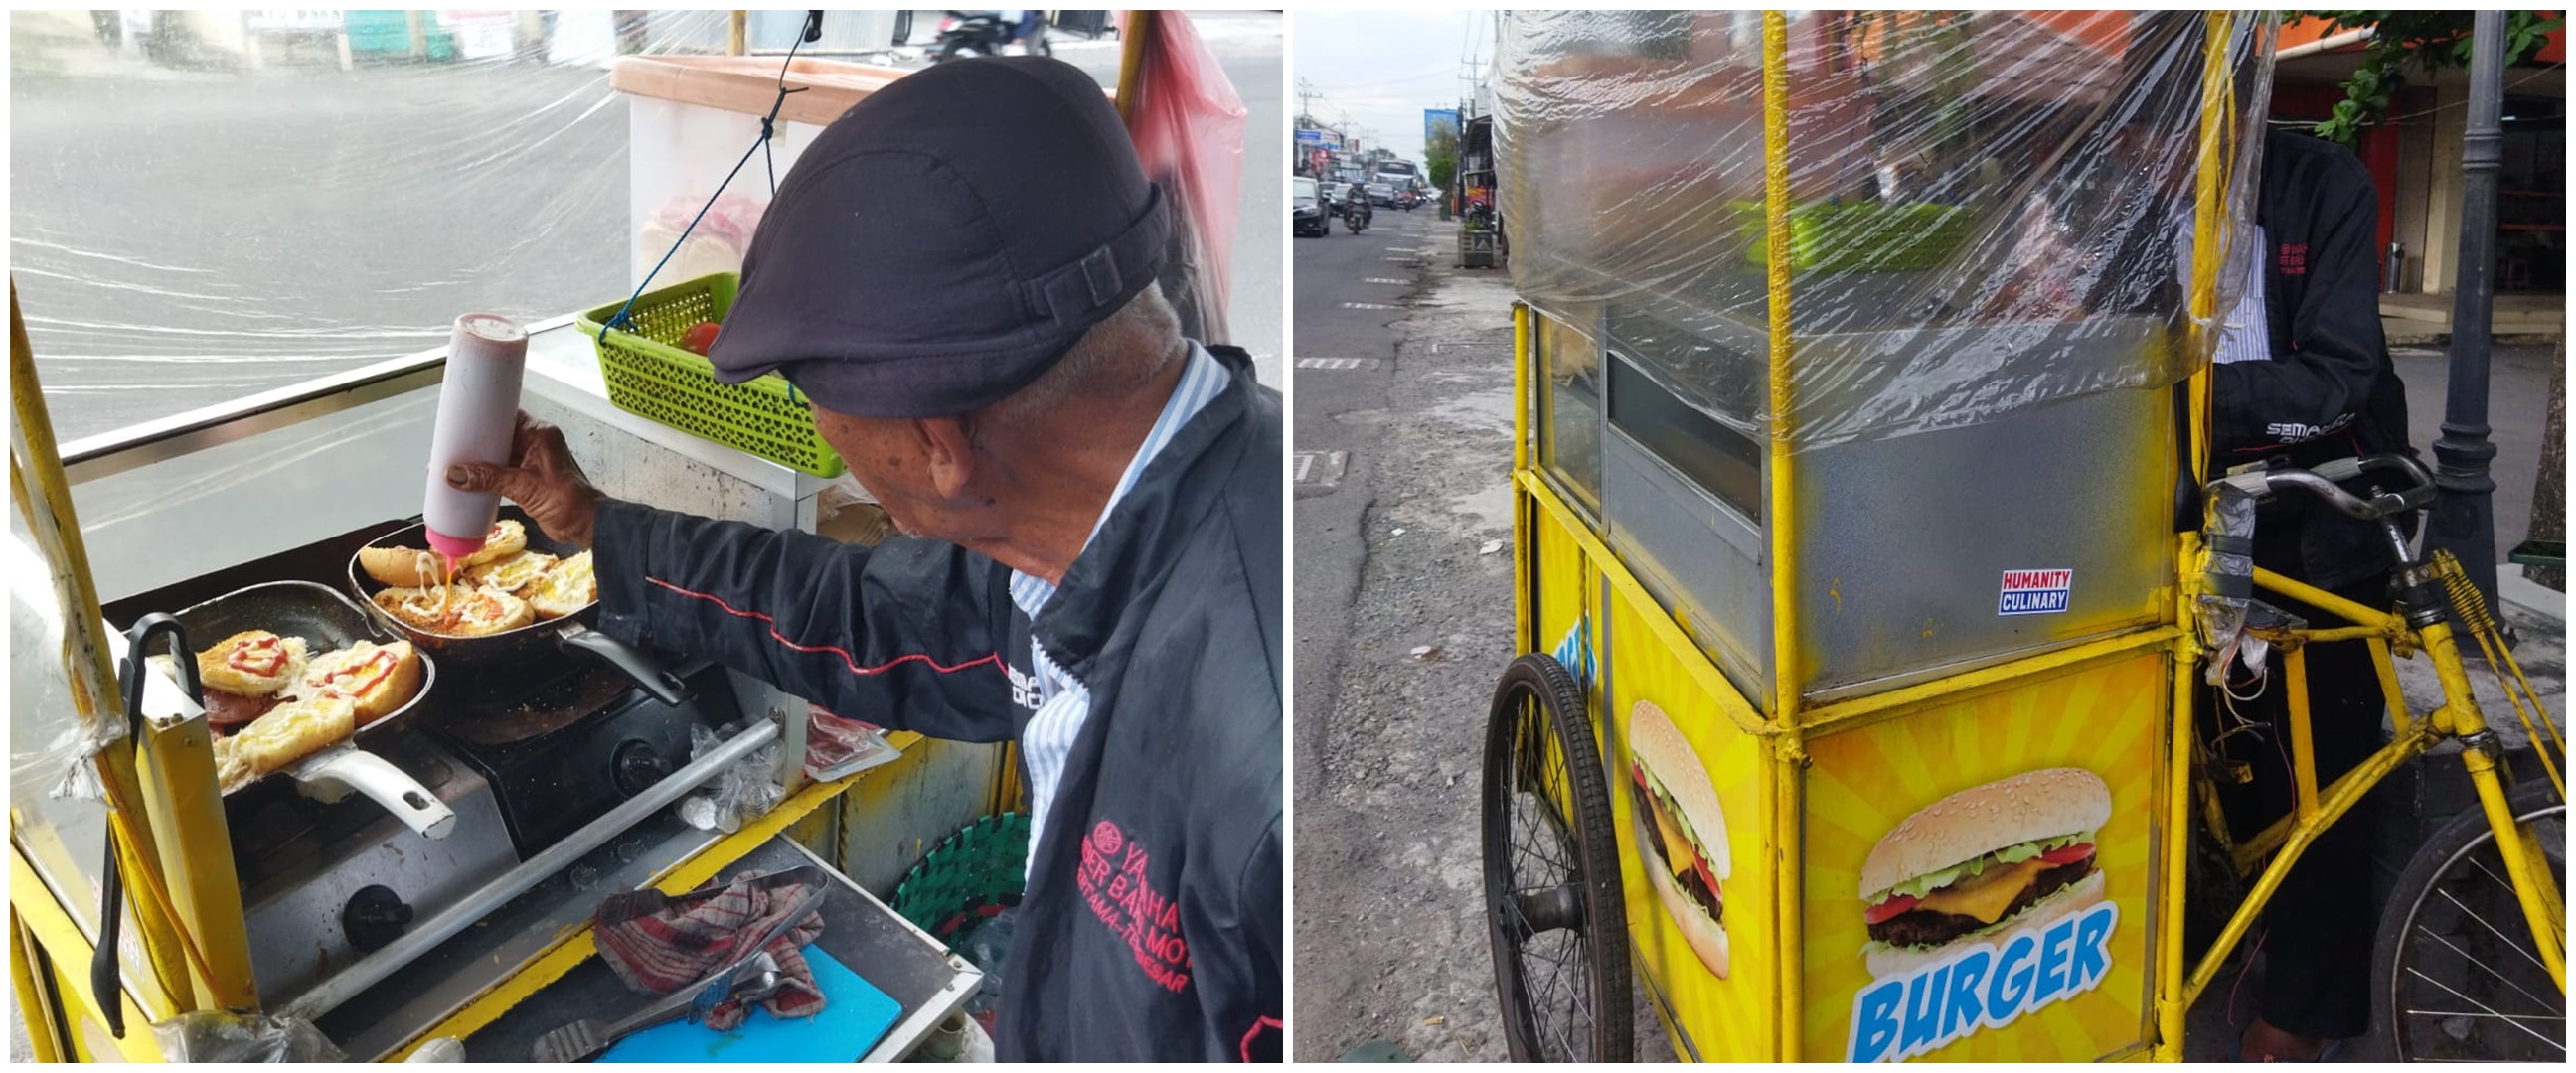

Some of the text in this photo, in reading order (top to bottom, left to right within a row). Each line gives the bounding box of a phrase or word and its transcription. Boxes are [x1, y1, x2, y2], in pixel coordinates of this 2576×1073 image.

[2003, 570, 2070, 589] HUMANITY
[2002, 591, 2066, 611] CULINARY
[1852, 906, 2115, 1063] BURGER
